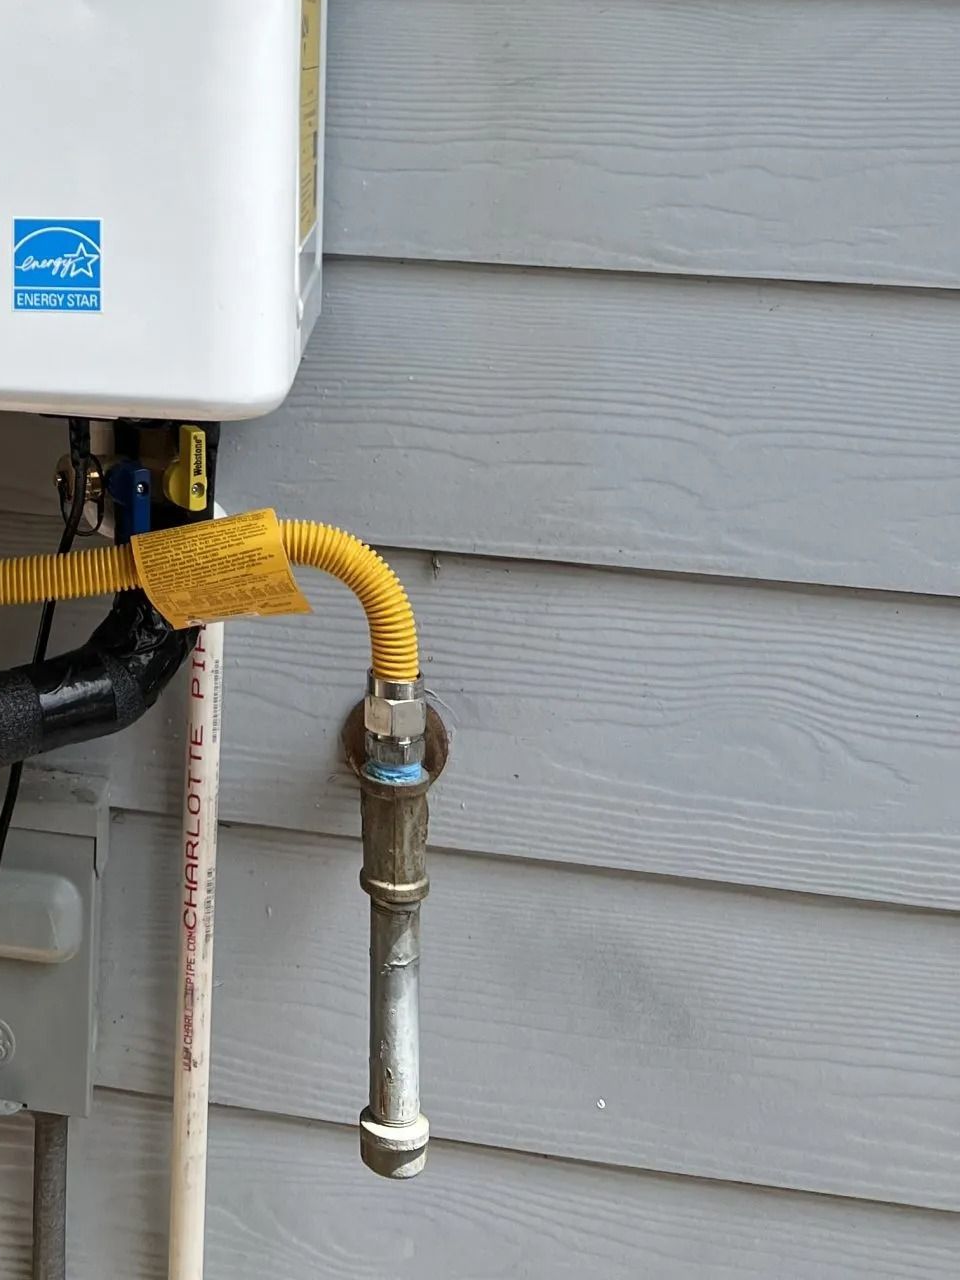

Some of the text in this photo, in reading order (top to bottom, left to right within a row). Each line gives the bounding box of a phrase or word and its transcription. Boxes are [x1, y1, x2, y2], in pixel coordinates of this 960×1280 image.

[16, 292, 99, 308] ENERGY STAR
[191, 623, 207, 699] PIP
[183, 724, 204, 930] CHARLOTTE
